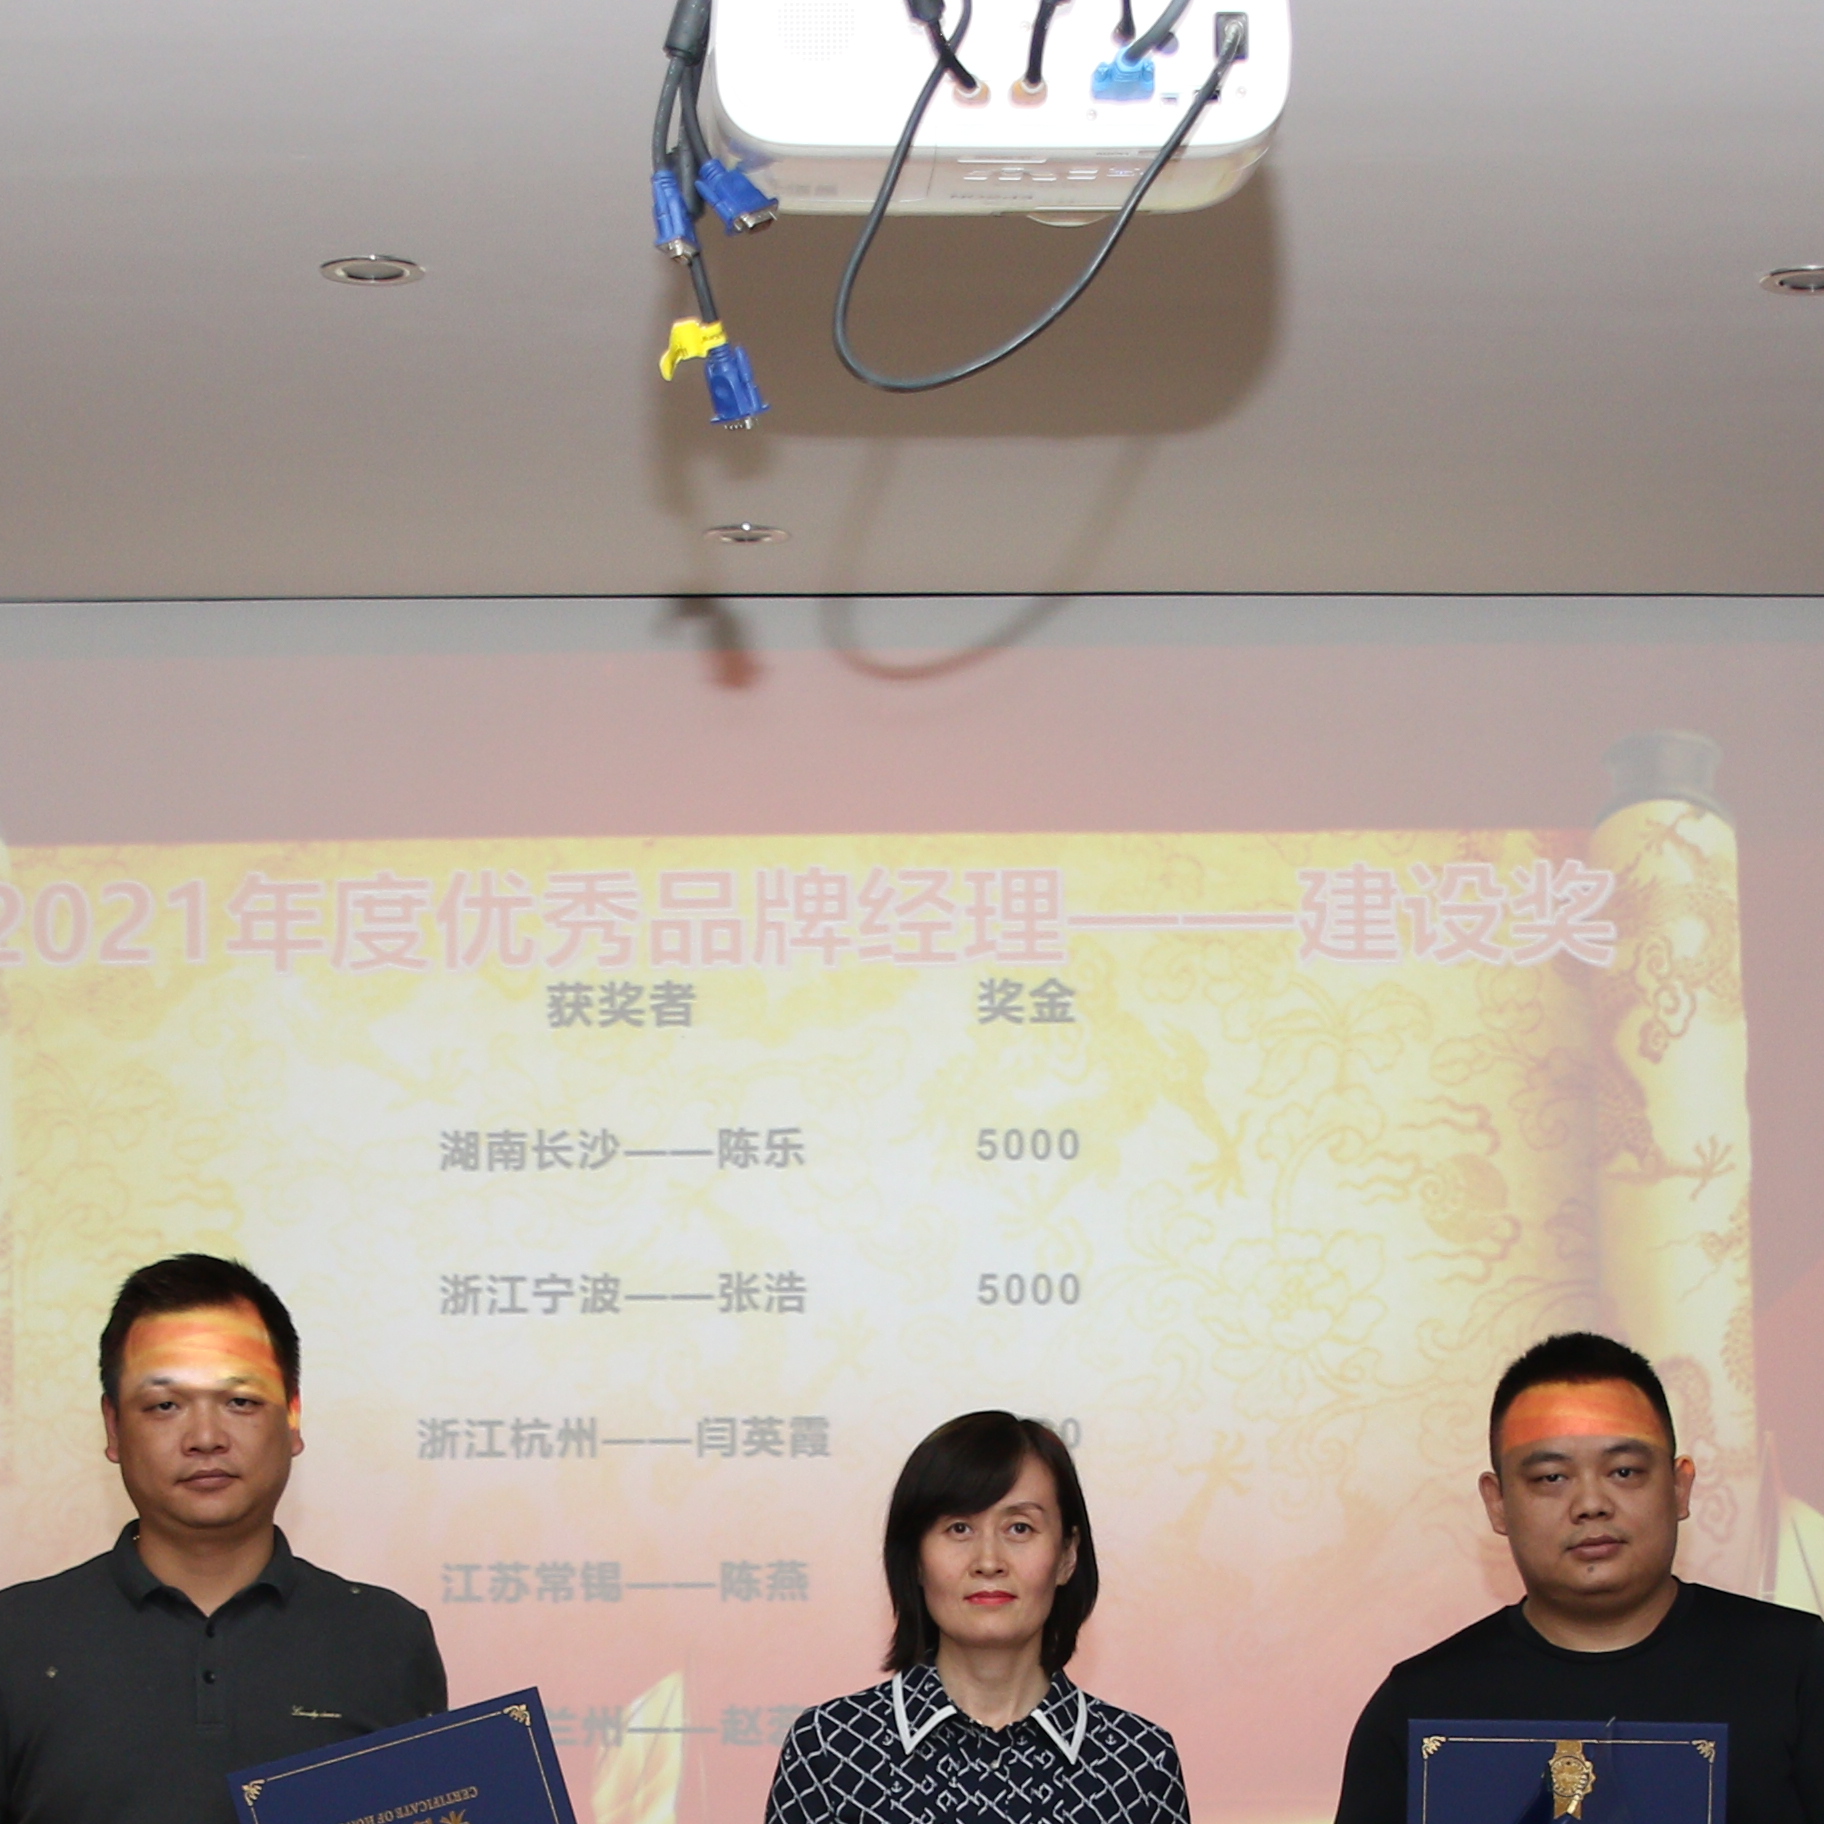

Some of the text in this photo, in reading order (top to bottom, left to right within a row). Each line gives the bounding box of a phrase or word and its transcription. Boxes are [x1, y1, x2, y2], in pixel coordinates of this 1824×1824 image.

[546, 979, 695, 1029] 获奖者
[976, 976, 1077, 1026] 奖金
[976, 1127, 1080, 1162] 5000
[977, 1273, 1081, 1306] 5000
[394, 1785, 479, 1819] CERTIFICATE
